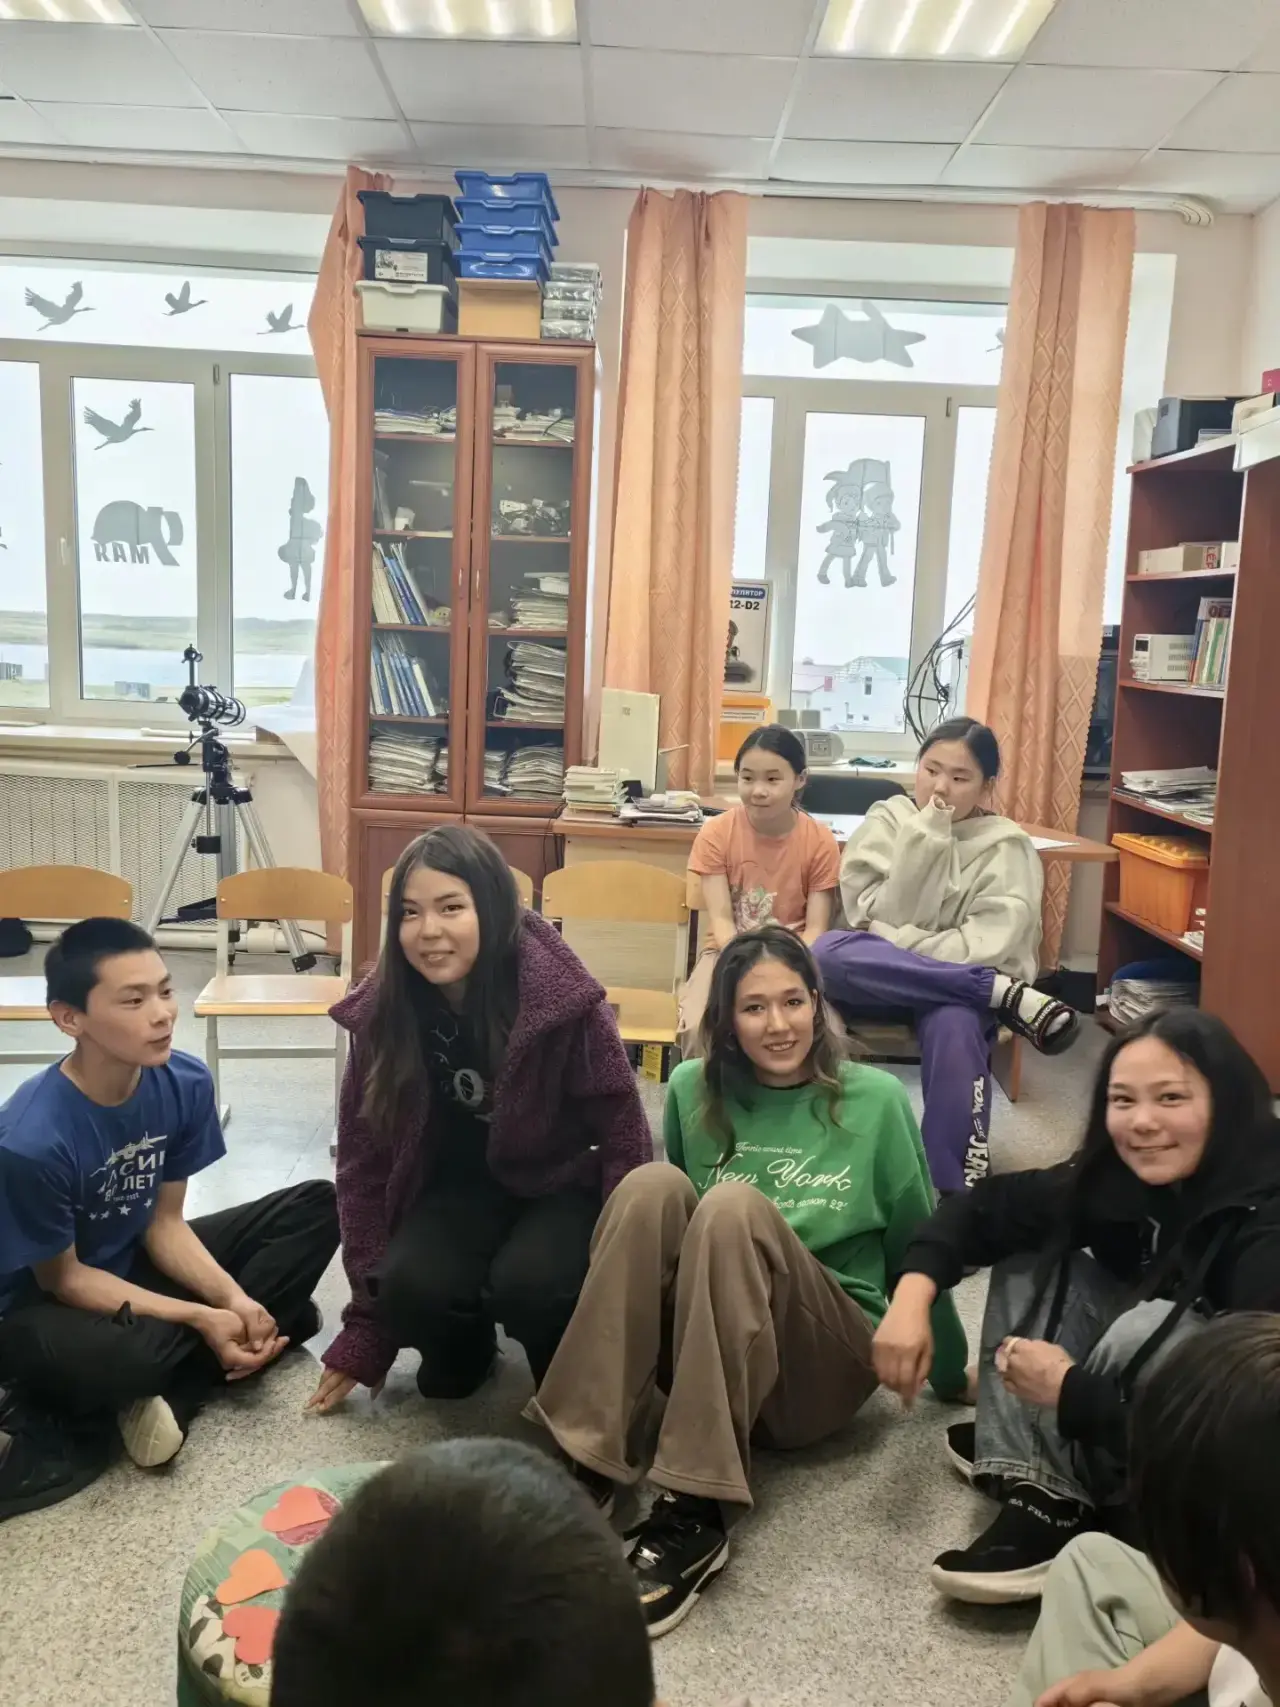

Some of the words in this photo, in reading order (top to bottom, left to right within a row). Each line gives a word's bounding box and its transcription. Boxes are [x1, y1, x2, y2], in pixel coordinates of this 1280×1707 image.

[972, 1076, 985, 1113] TOM
[122, 1172, 156, 1191] ЛЕТ
[697, 1153, 759, 1189] New
[767, 1155, 852, 1191] York
[1027, 1504, 1051, 1524] FILA
